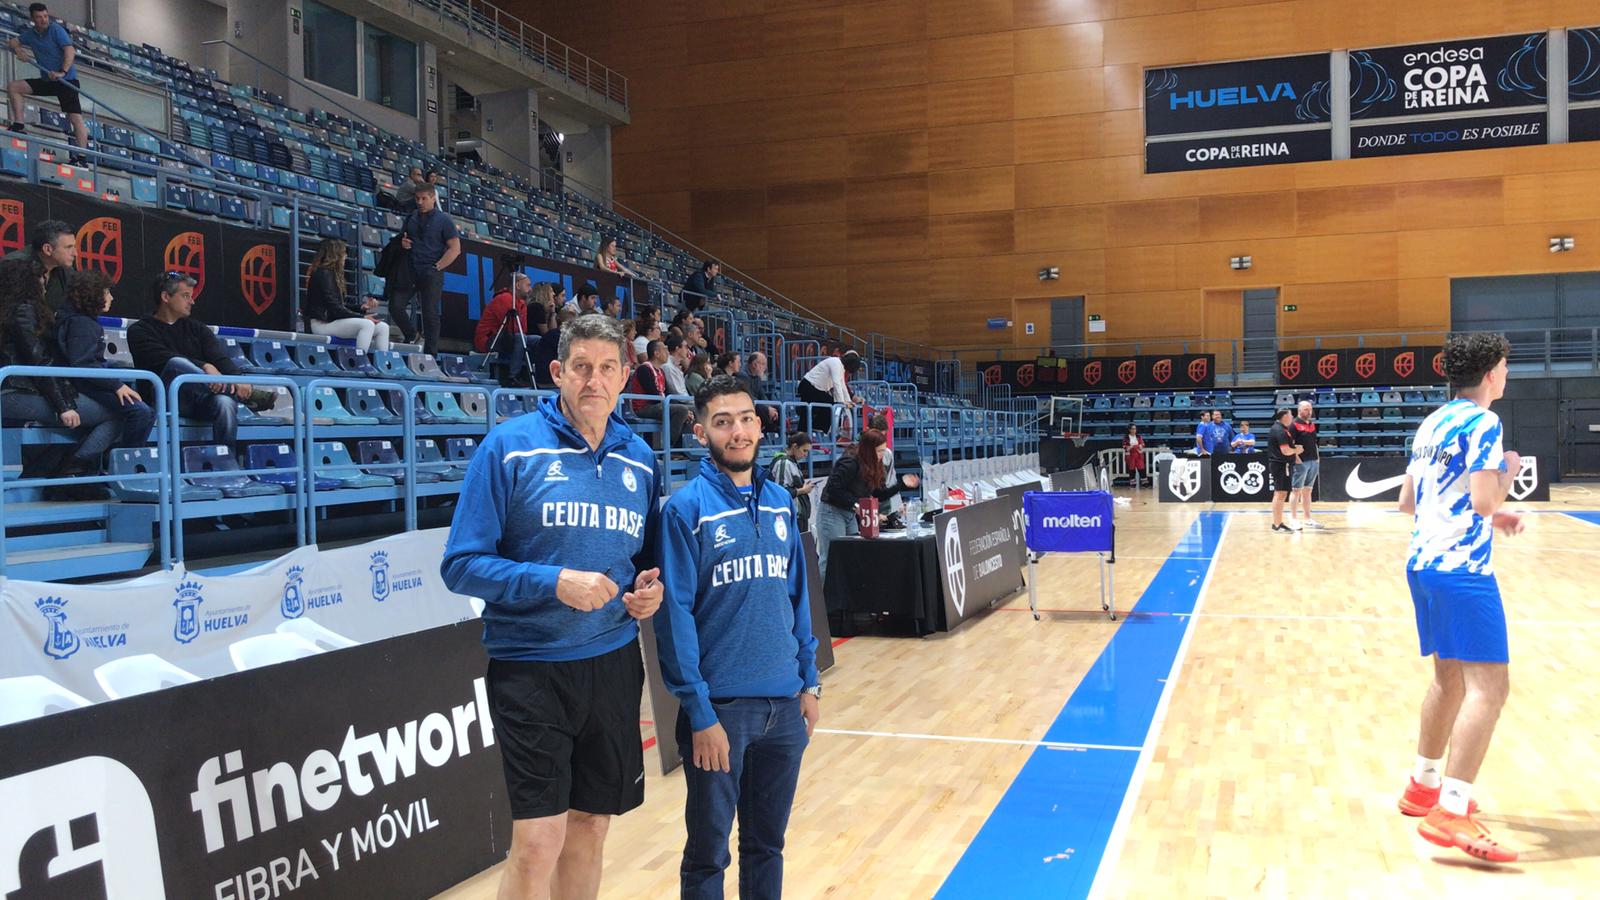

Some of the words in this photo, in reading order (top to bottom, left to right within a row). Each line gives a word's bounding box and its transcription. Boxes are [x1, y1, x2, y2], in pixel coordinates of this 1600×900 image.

[1403, 46, 1484, 66] endesa
[1403, 63, 1487, 91] COPA
[1170, 82, 1297, 110] HUELVA
[1405, 91, 1418, 100] DE
[1405, 99, 1419, 109] LA
[1421, 85, 1490, 108] REINA
[1358, 133, 1407, 148] DONDE
[1410, 131, 1459, 144] TODO
[1462, 128, 1480, 141] ES
[1480, 122, 1541, 140] POSIBLE
[1185, 146, 1230, 162] COPA
[1230, 145, 1241, 153] DE
[1241, 142, 1290, 158] REINA
[102, 221, 118, 231] FEB
[542, 501, 600, 529] CEUTA
[605, 505, 644, 538] BASE
[1042, 514, 1102, 528] molten
[712, 554, 763, 587] CEUTA
[392, 577, 422, 592] HUELVA
[307, 592, 343, 609] HUELVA
[204, 613, 248, 632] HUELVA
[321, 832, 343, 871] Y
[351, 798, 439, 861] MÓVIL
